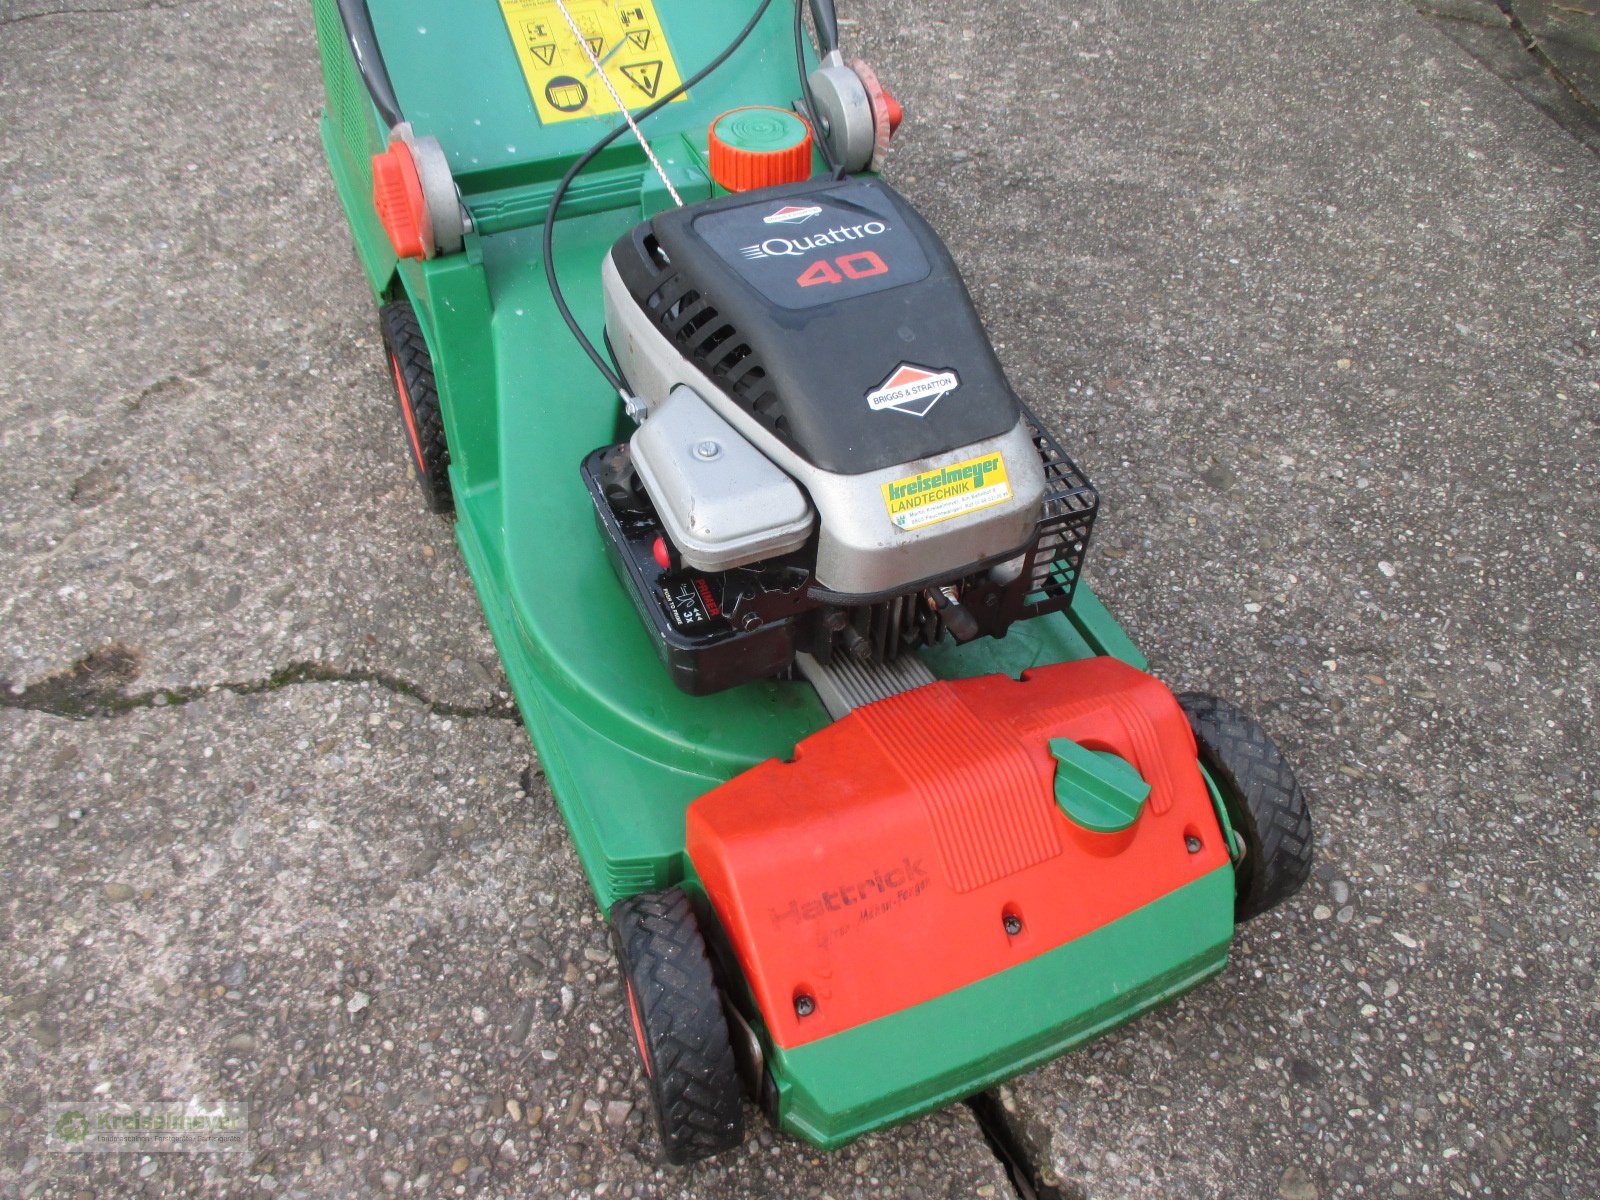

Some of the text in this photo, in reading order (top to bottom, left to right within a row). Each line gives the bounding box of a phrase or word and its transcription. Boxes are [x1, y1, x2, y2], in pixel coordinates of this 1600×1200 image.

[762, 221, 886, 256] Quattro
[796, 250, 889, 288] 40
[872, 377, 952, 405] BRIGGS & STRATTON
[888, 457, 999, 501] kreiselmeyer
[891, 481, 970, 514] LANDTECHNIK
[662, 588, 684, 626] PUSH TO PRIME
[695, 579, 721, 616] PRIMER
[768, 857, 929, 931] Hattrick
